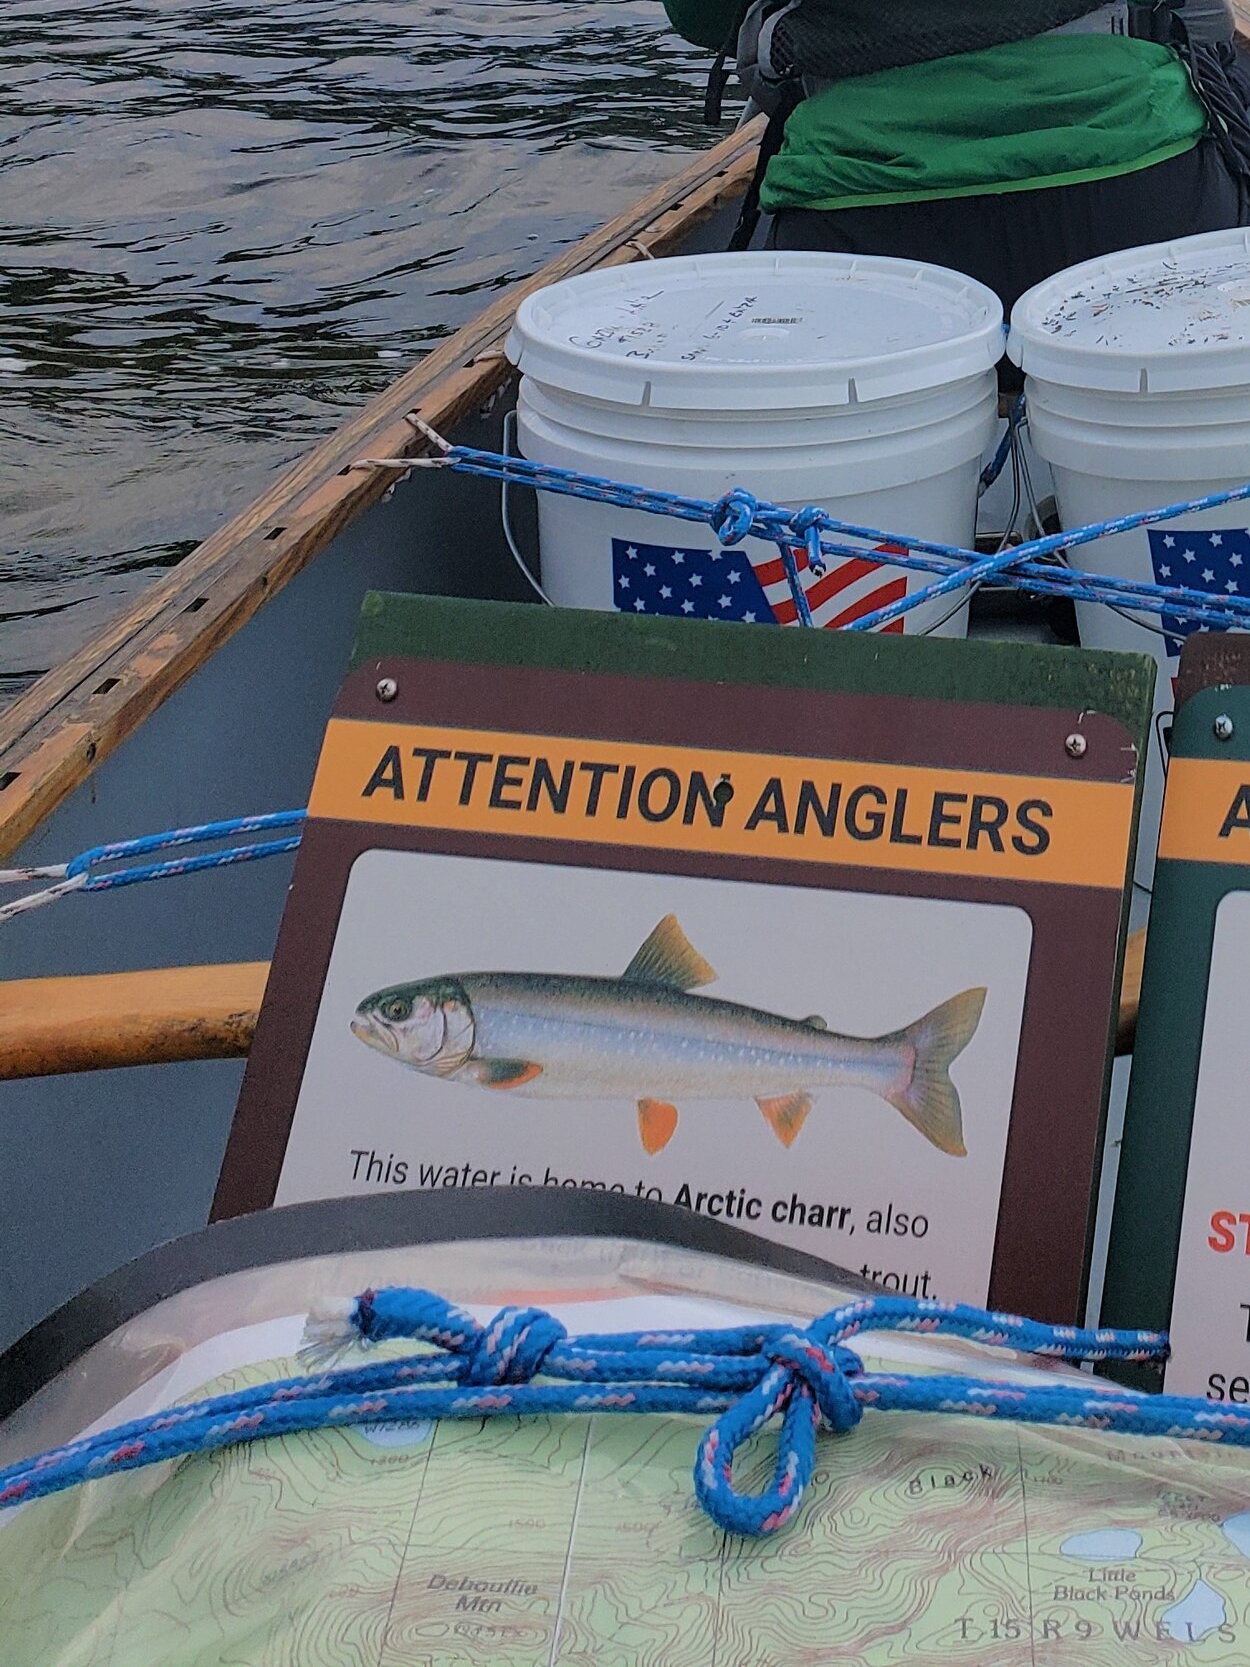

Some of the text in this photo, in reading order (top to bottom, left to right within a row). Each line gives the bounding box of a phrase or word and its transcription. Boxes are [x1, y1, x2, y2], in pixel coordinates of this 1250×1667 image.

[361, 745, 1054, 857] ATTENTION ANGLERS
[350, 1149, 408, 1185] This
[418, 1163, 501, 1187] water
[673, 1183, 761, 1221] Arctic
[771, 1192, 855, 1235] charr,
[866, 1203, 929, 1238] also
[1053, 1585, 1175, 1601] Black Ponds
[1088, 1567, 1137, 1583] Little
